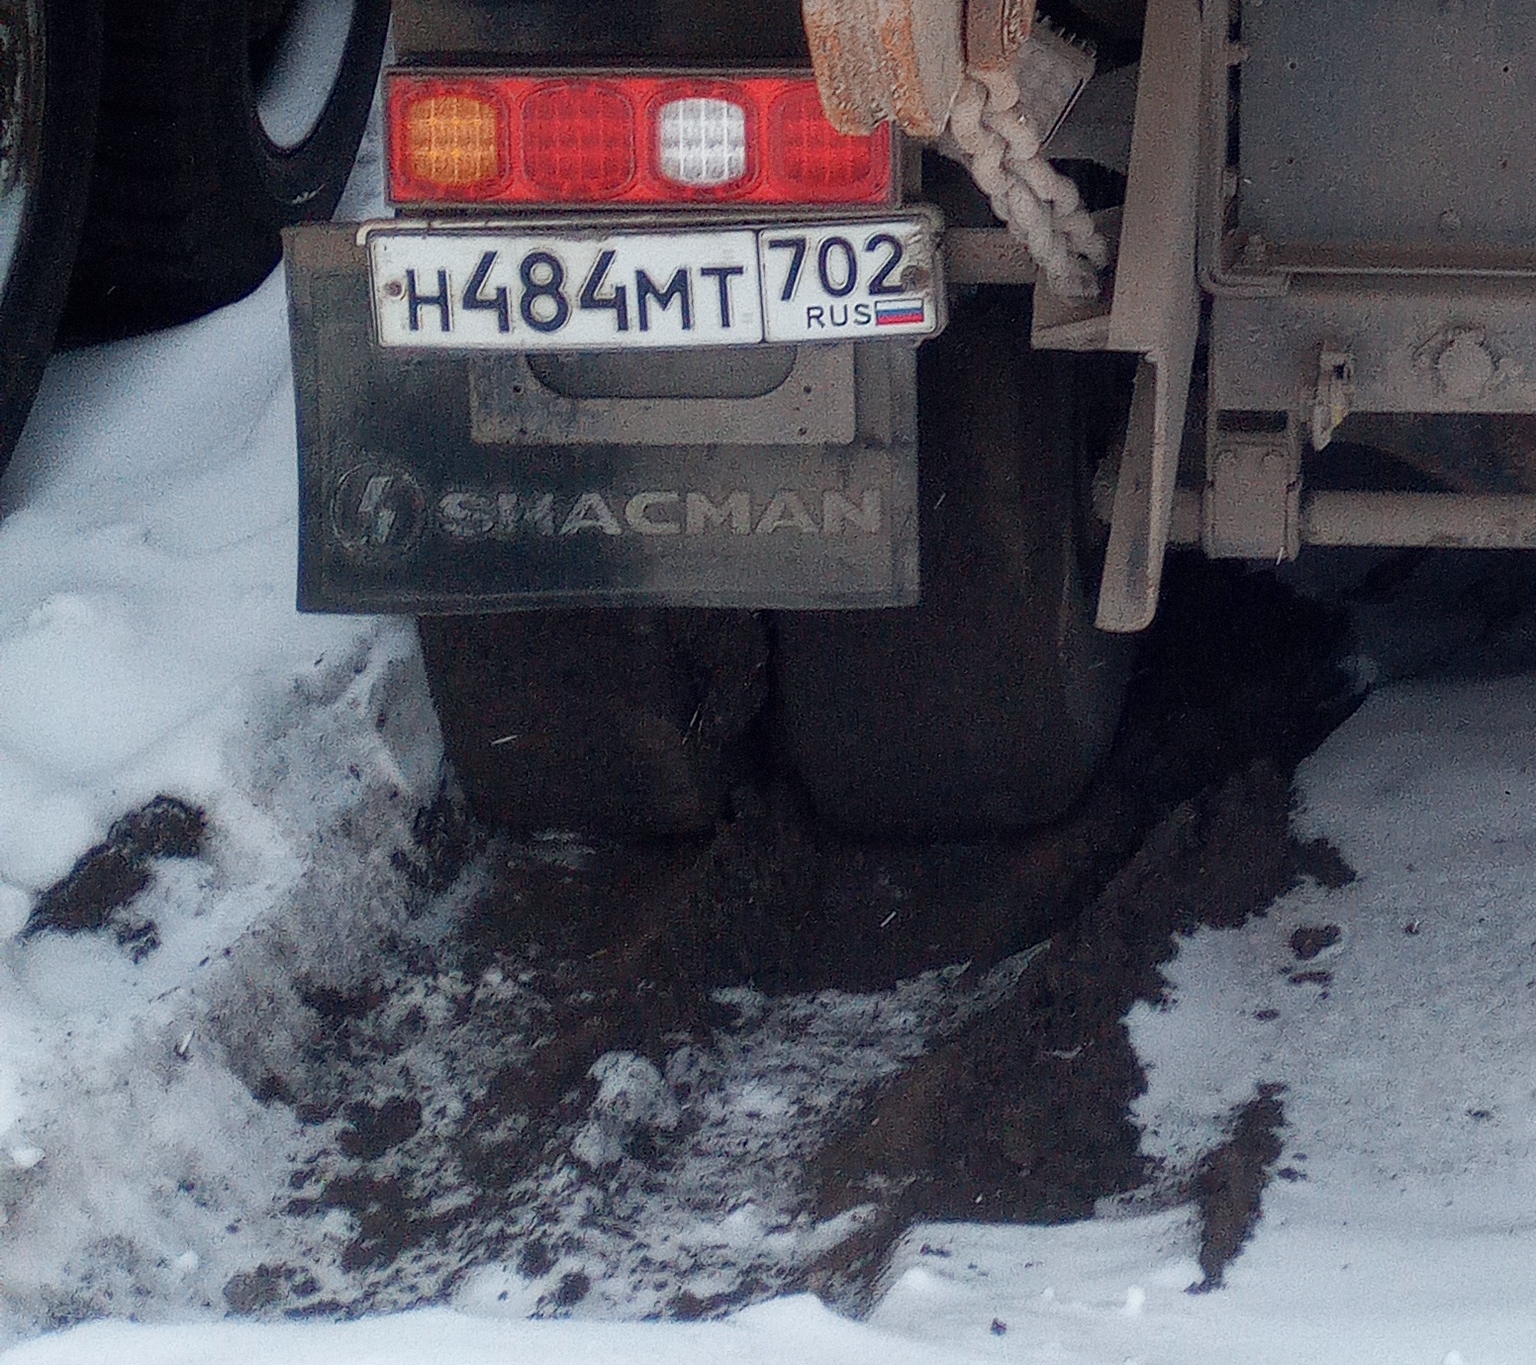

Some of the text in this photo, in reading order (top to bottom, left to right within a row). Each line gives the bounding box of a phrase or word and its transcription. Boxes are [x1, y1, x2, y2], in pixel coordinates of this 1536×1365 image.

[767, 234, 904, 303] 702
[805, 303, 872, 329] RUS
[437, 488, 885, 537] SHACMAN
